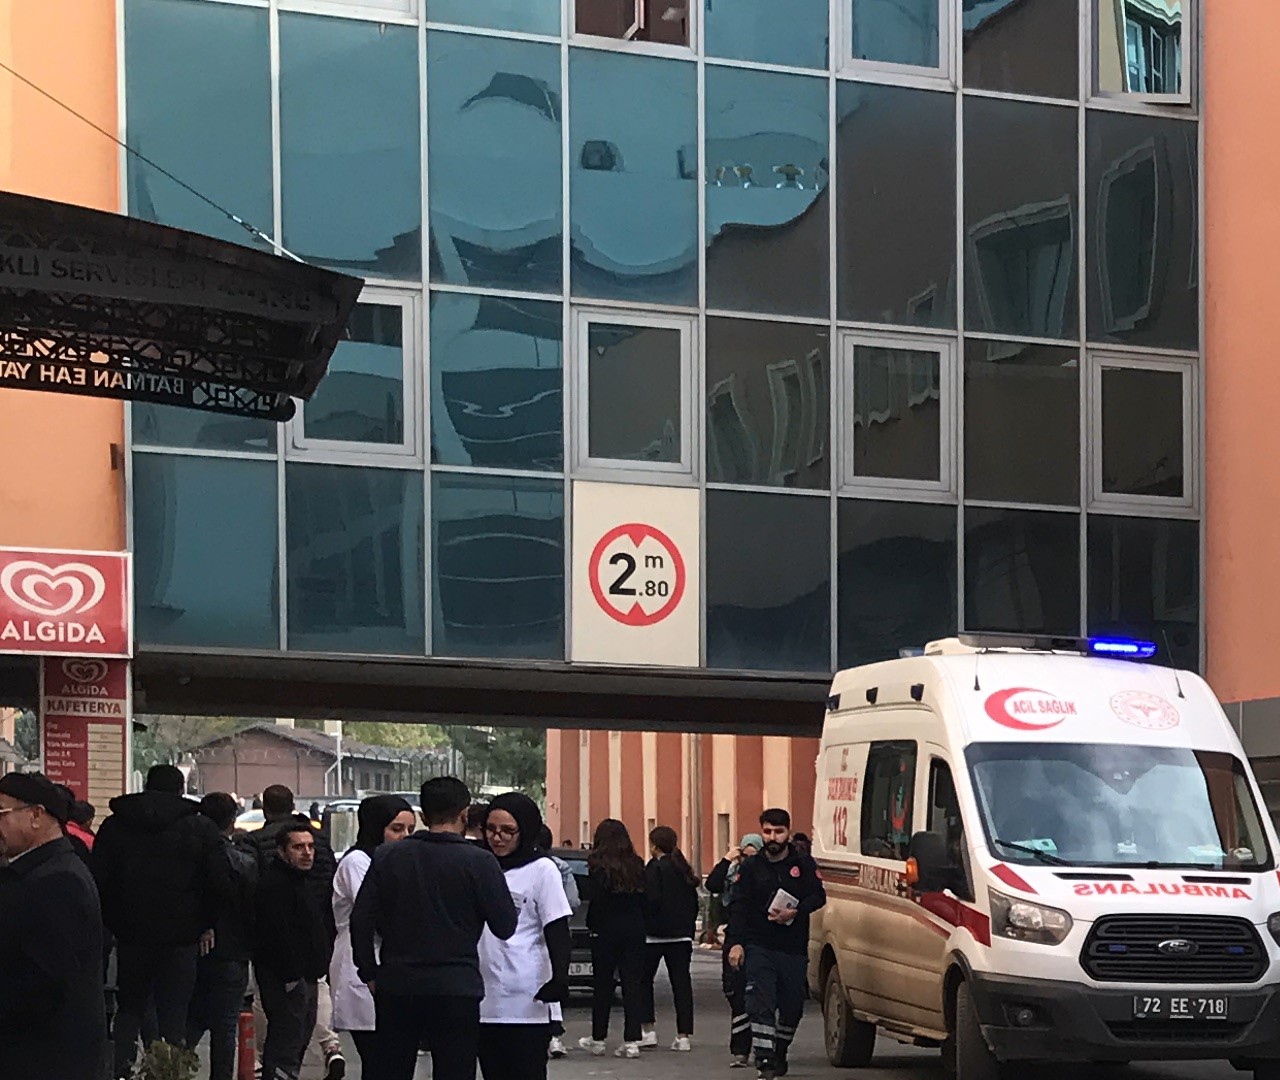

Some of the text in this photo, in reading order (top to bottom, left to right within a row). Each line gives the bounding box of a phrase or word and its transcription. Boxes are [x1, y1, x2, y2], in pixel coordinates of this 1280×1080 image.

[47, 700, 122, 715] KAFETERYA
[833, 806, 848, 846] 112
[1143, 997, 1224, 1014] 72 EE 718
